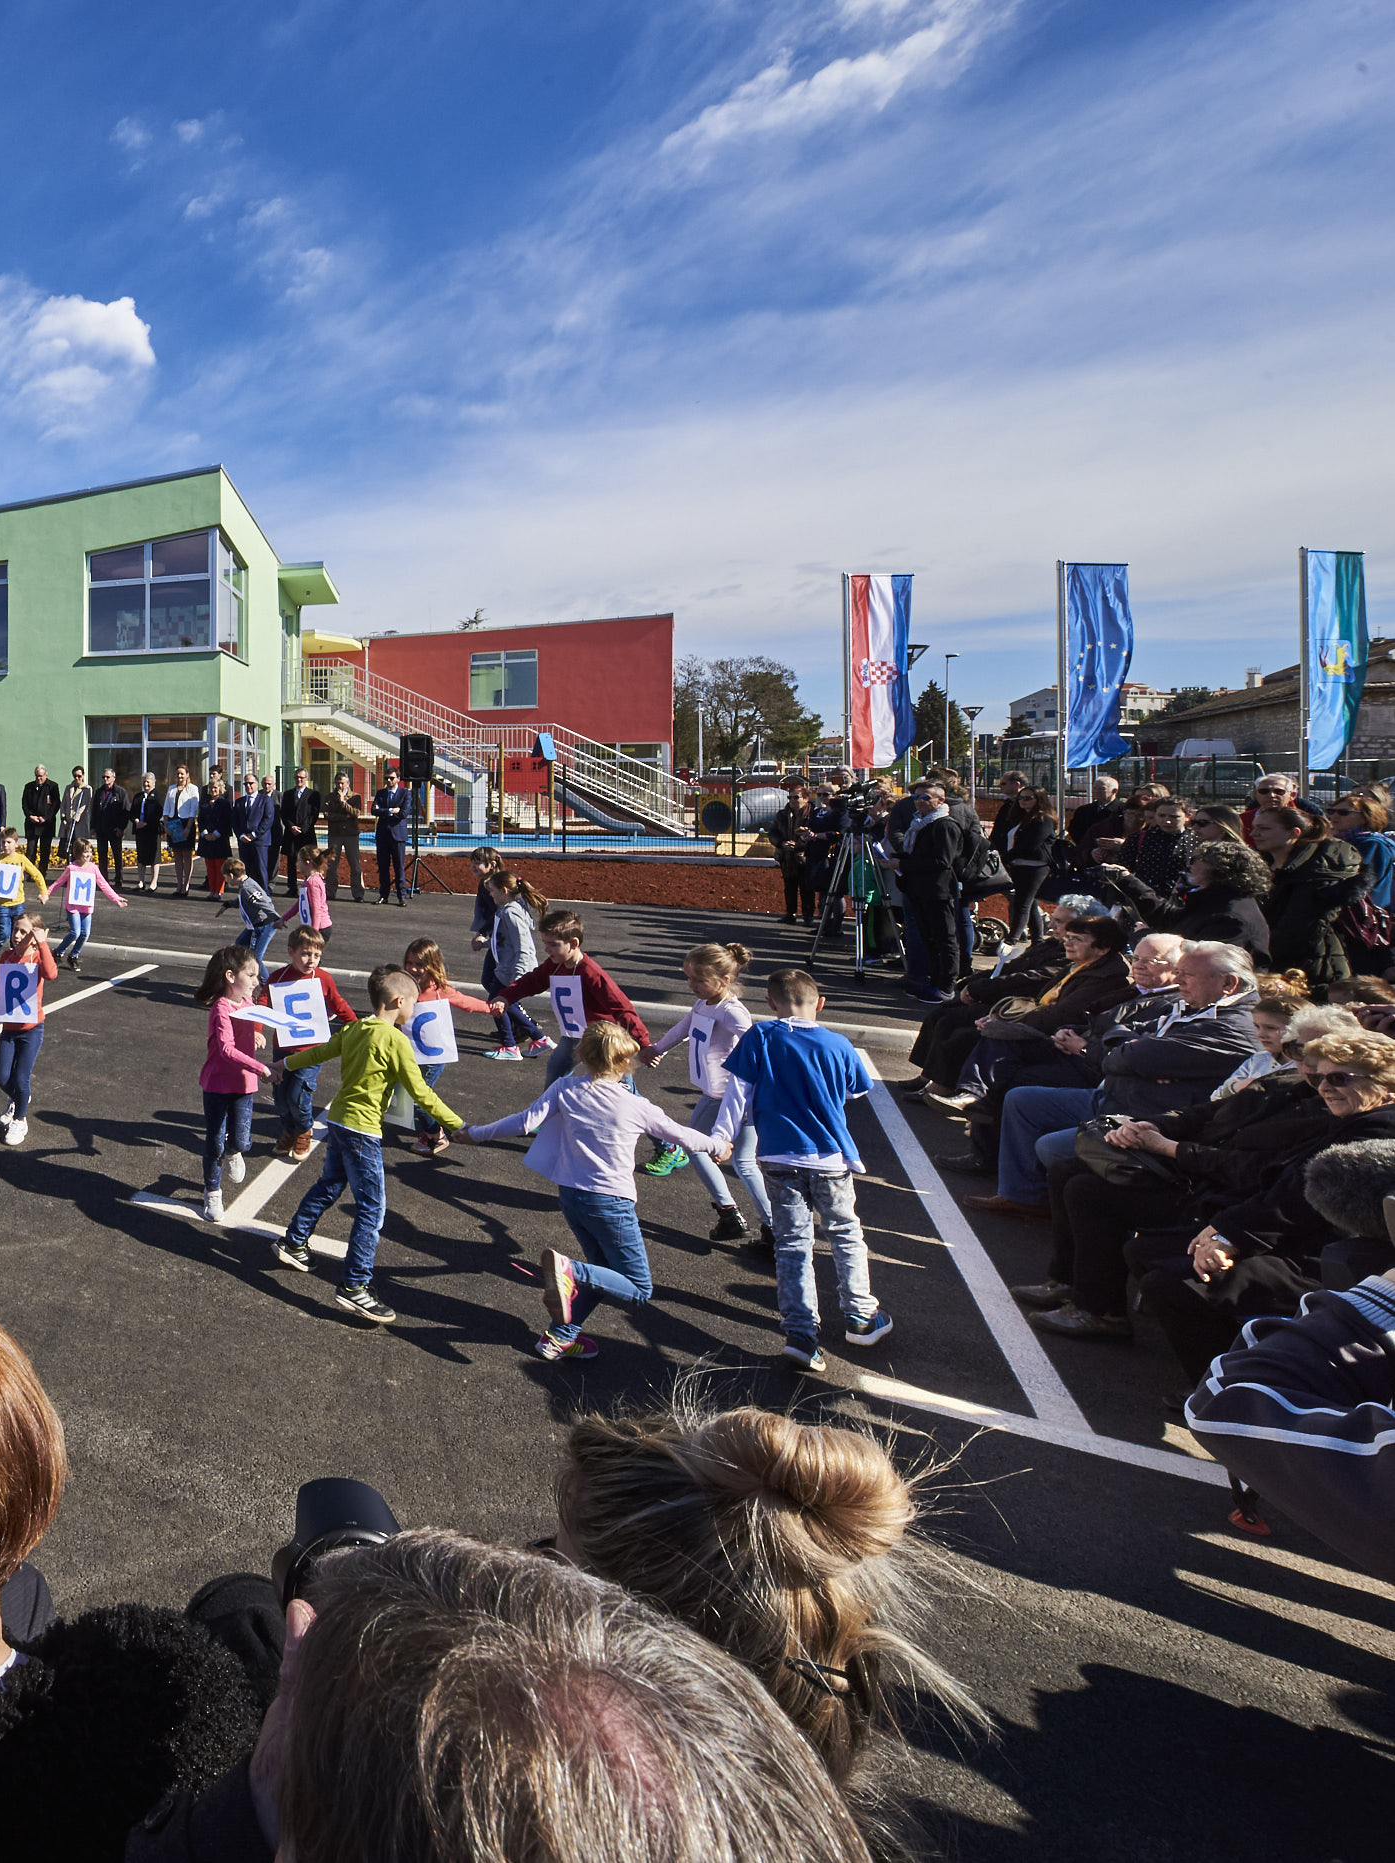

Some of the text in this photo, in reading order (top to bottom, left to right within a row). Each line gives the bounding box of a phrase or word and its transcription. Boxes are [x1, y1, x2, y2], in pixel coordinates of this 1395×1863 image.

[74, 877, 92, 902] M
[5, 970, 31, 1016] R
[284, 992, 315, 1039] E
[555, 986, 580, 1032] E
[411, 1011, 444, 1057] C
[691, 1027, 707, 1080] T
